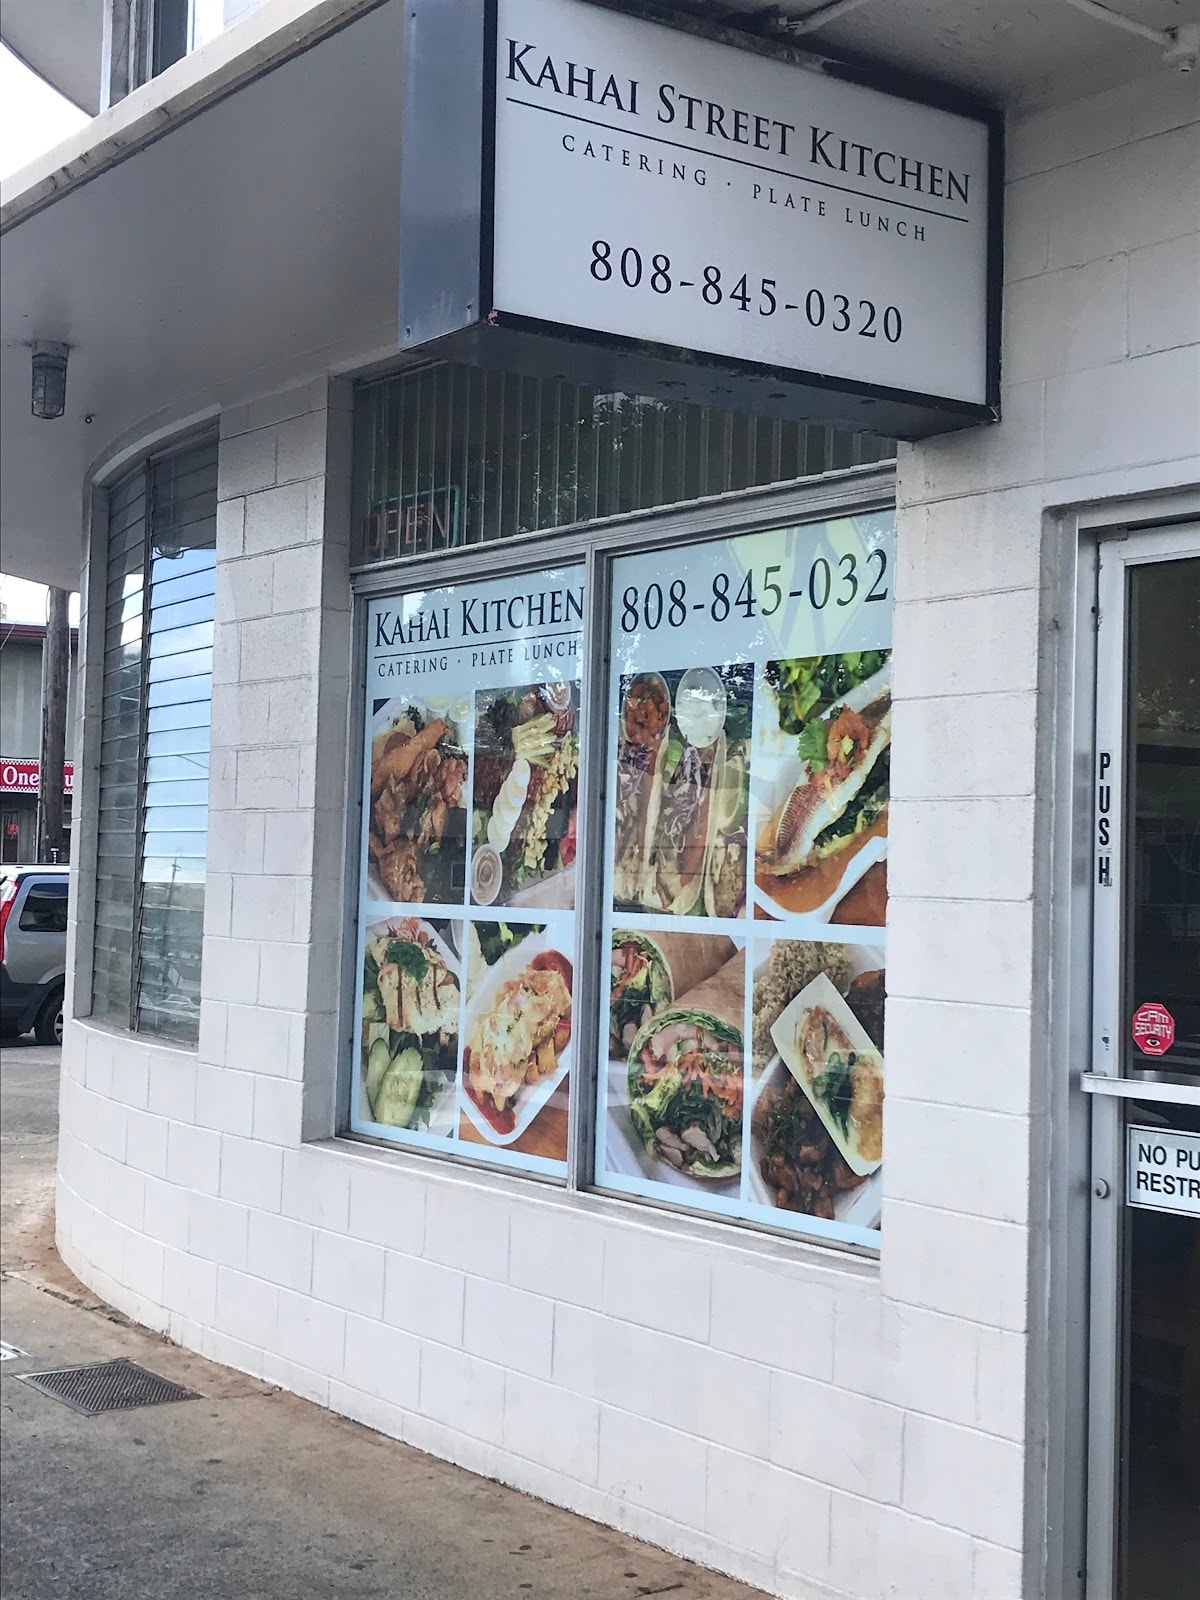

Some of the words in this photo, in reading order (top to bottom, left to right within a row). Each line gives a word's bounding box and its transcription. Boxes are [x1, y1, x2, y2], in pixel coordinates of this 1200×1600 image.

[505, 38, 641, 116] KAHAI
[657, 83, 796, 157] STREET
[808, 125, 971, 205] KITCHEN
[562, 134, 708, 187] CATERING
[752, 183, 827, 217] PLATE
[844, 207, 927, 242] LUNCH
[589, 239, 902, 344] 808-845-0320
[375, 608, 451, 648] KAHAI
[461, 586, 586, 637] KITCHEN
[378, 656, 448, 678] CATERING
[471, 648, 514, 668] PLATE
[524, 640, 578, 661] LUNCH
[2, 765, 39, 786] One
[1098, 752, 1111, 886] PUSH
[1138, 1143, 1167, 1166] NO
